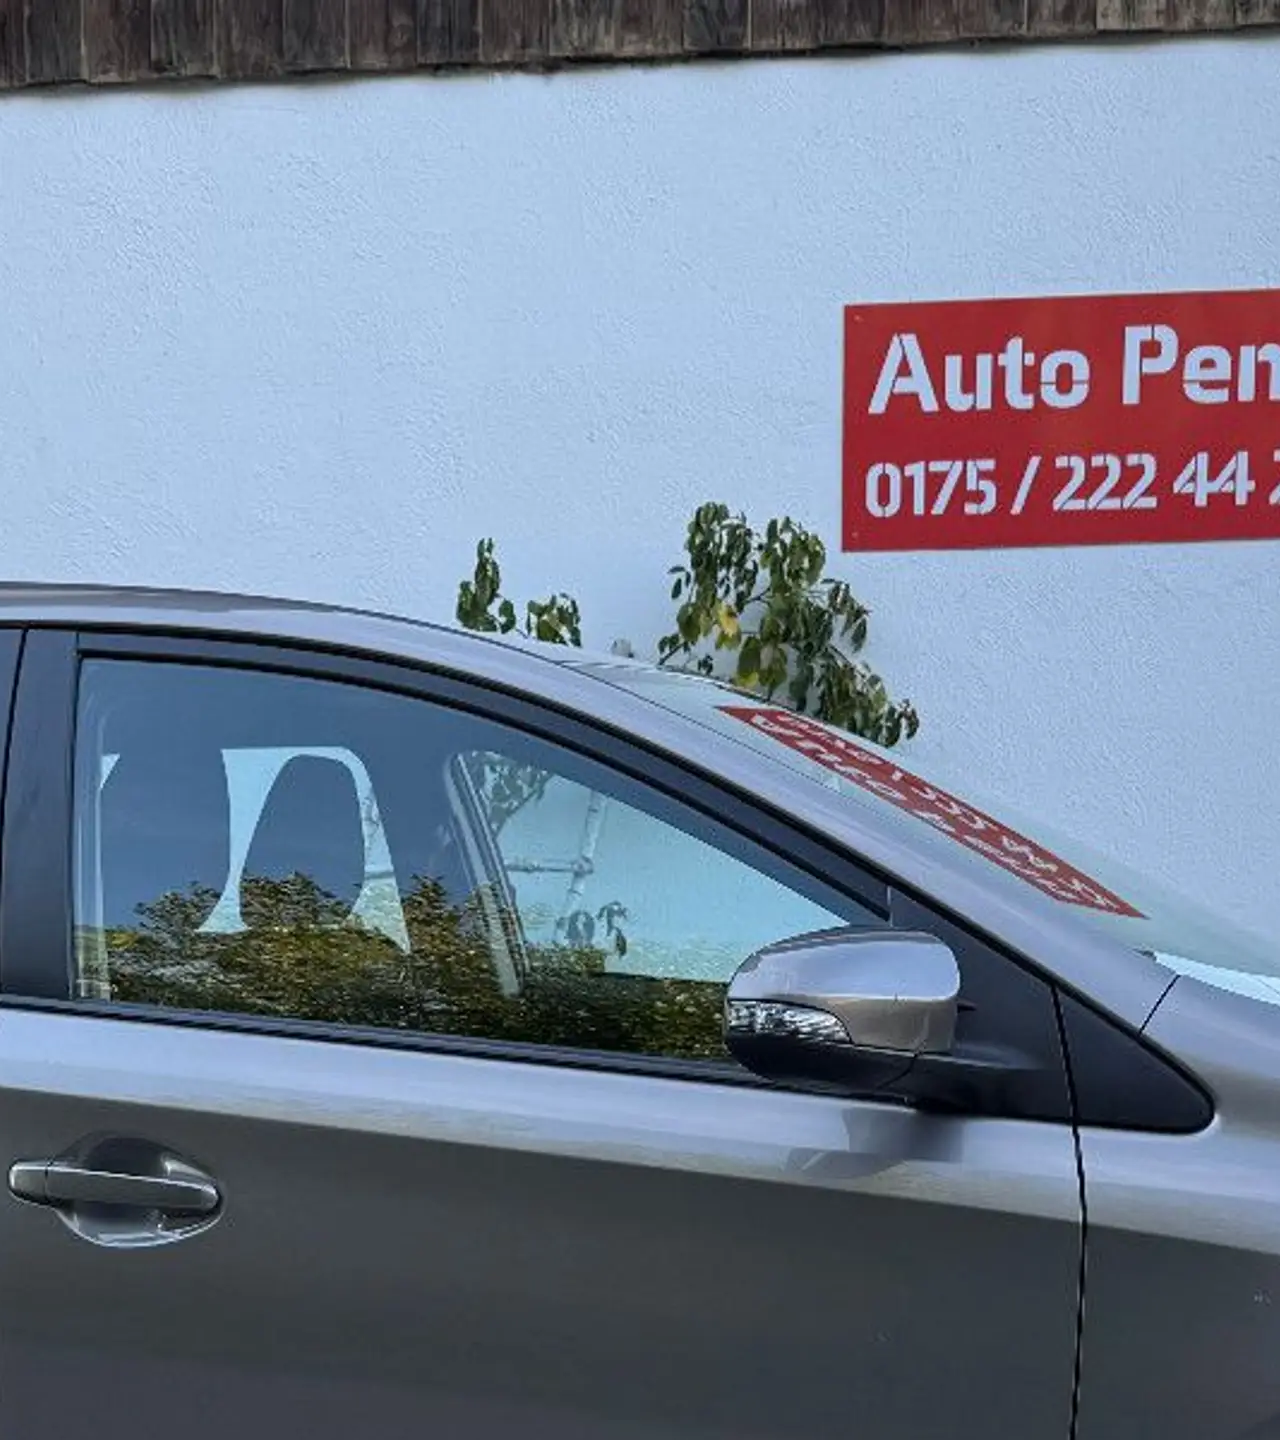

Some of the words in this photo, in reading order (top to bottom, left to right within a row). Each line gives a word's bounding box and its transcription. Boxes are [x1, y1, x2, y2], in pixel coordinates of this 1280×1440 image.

[867, 333, 1091, 415] Auto
[865, 459, 997, 518] 0175
[1010, 456, 1041, 515] /
[1052, 453, 1158, 512] 222
[1173, 451, 1255, 508] 44
